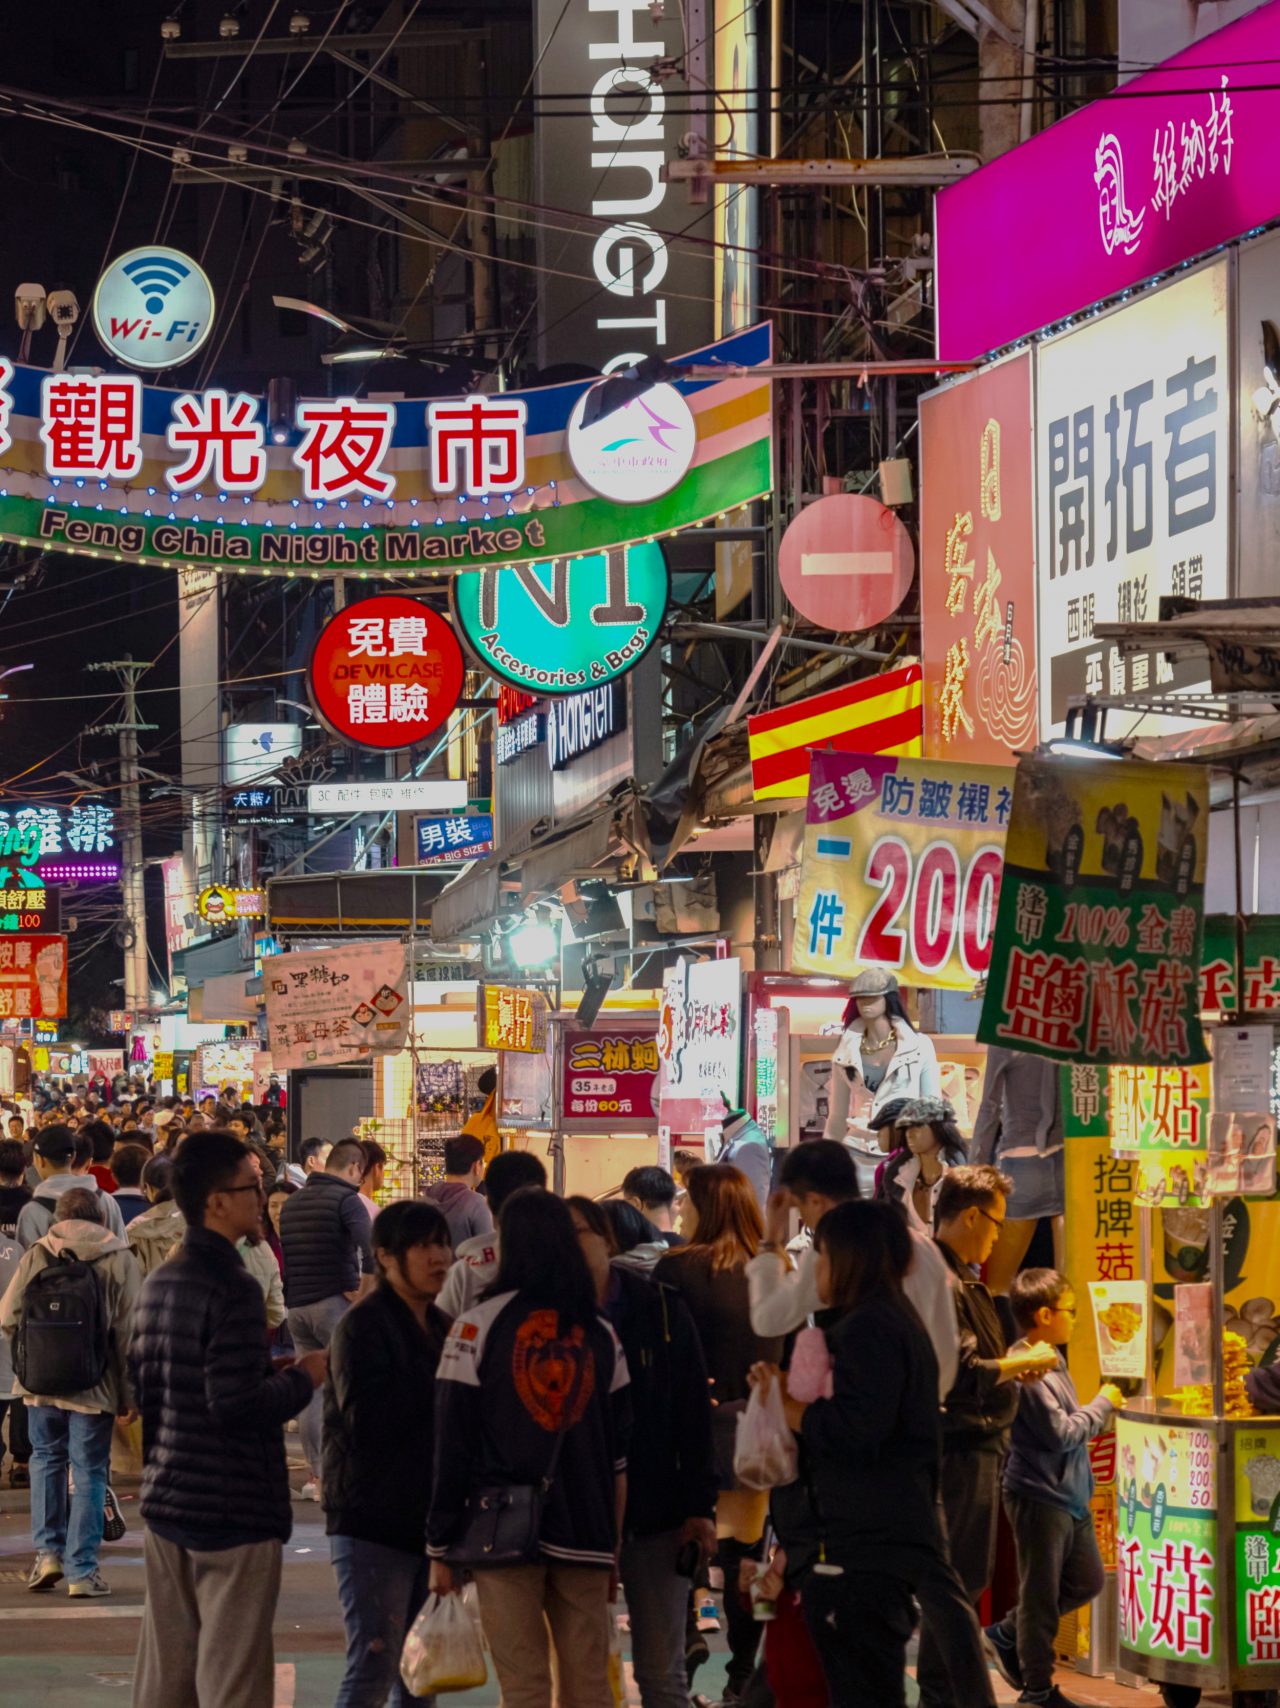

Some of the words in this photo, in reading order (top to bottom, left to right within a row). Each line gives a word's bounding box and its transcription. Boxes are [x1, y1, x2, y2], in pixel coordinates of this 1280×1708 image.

[110, 316, 200, 343] Wi-Fi
[1049, 355, 1218, 580] 開拓者
[41, 507, 144, 556] Feng
[152, 524, 252, 560] Chia
[261, 532, 379, 565] Night
[385, 518, 547, 563] Market
[347, 616, 428, 658] 免費
[1067, 593, 1094, 643] 西服
[333, 663, 443, 681] DEVILCASE
[480, 632, 587, 687] Accessories
[589, 661, 608, 680] &
[605, 628, 650, 670] Bags
[347, 683, 430, 724] 體驗
[233, 791, 271, 807] 天藍
[812, 768, 876, 817] 免燙
[420, 817, 474, 852] 男裝
[463, 846, 485, 857] SIZE
[859, 837, 1005, 976] 200
[1017, 885, 1048, 944] 逢甲
[1056, 903, 1131, 947] 100%
[1137, 903, 1196, 956] 全素
[999, 950, 1192, 1058] 鹽酥菇
[1094, 1154, 1135, 1281] 招牌菇
[1191, 1490, 1210, 1506] 50
[1246, 1536, 1269, 1583] 逢甲
